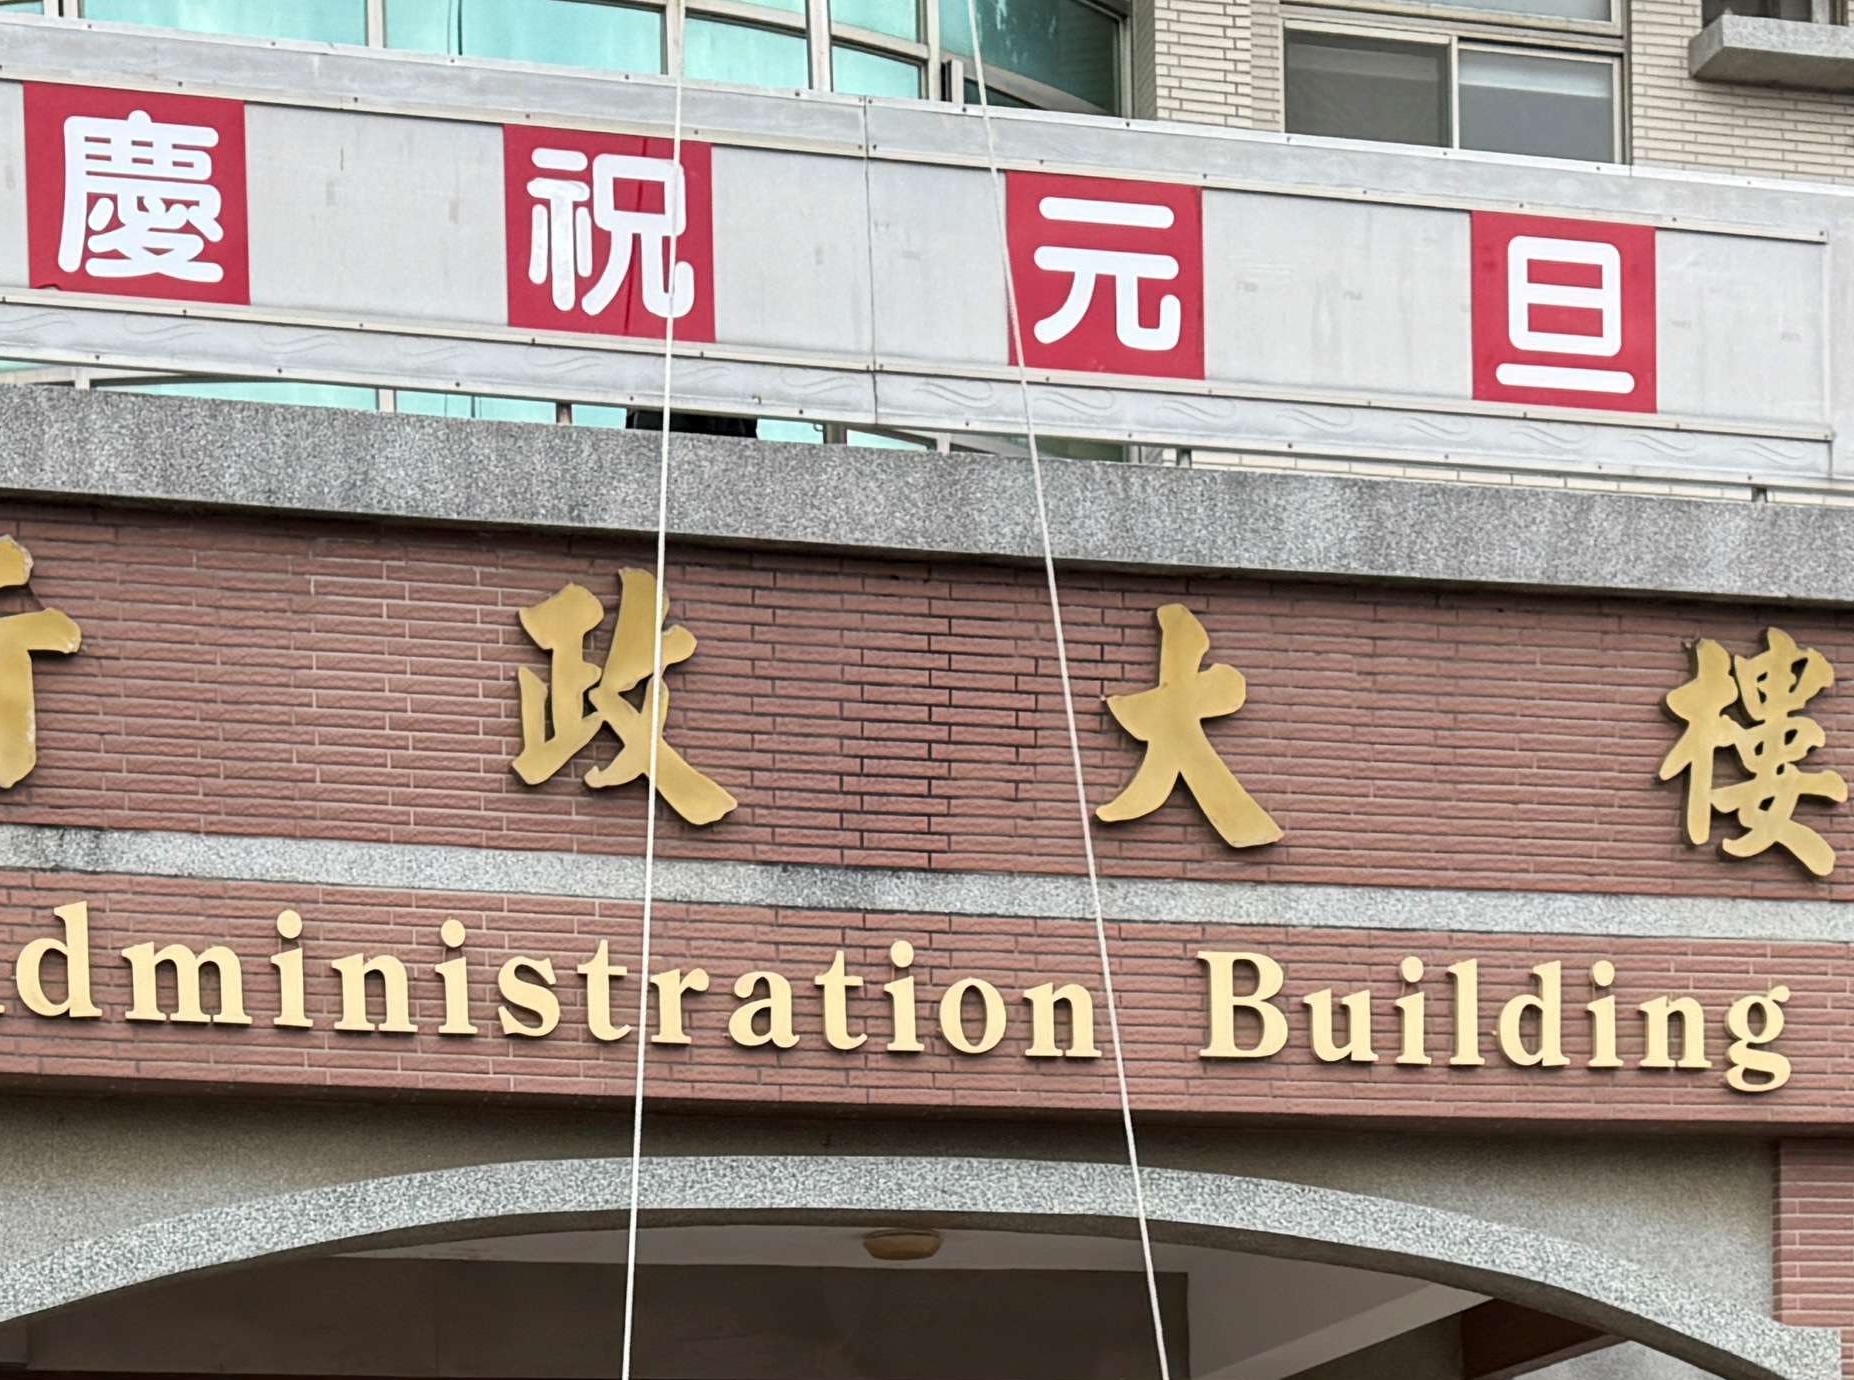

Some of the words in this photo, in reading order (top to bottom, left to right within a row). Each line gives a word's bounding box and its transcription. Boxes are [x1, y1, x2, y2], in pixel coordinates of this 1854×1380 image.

[56, 108, 1636, 397] 慶祝元旦
[1196, 950, 1792, 1094] Building
